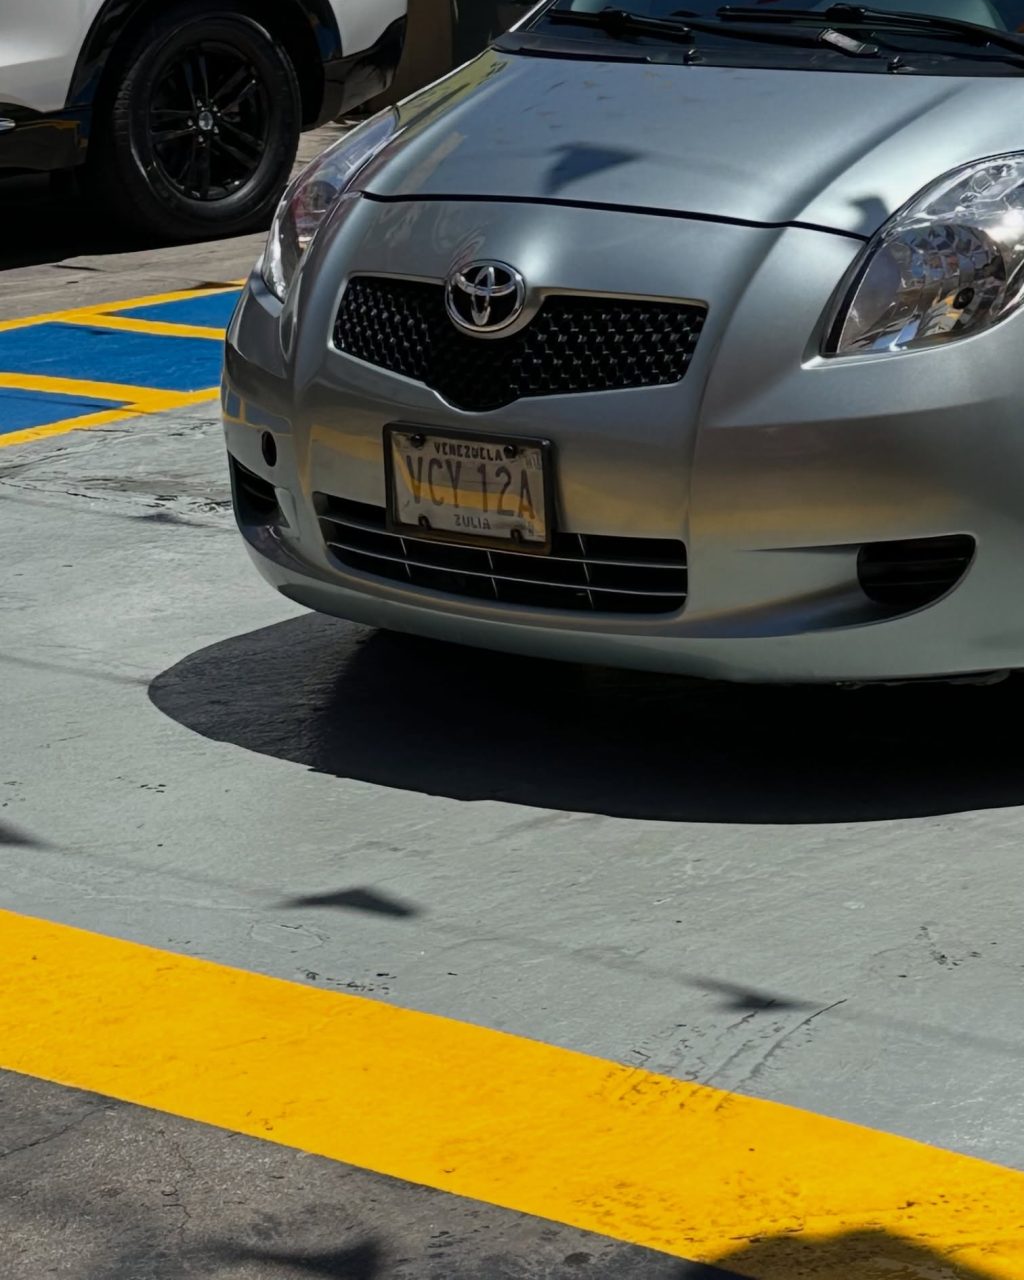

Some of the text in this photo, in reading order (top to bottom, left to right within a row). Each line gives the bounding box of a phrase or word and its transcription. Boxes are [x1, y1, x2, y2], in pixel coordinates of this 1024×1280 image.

[434, 442, 503, 462] VENEZUELA
[406, 455, 535, 520] VCY 12A
[454, 514, 492, 530] ZULIA
